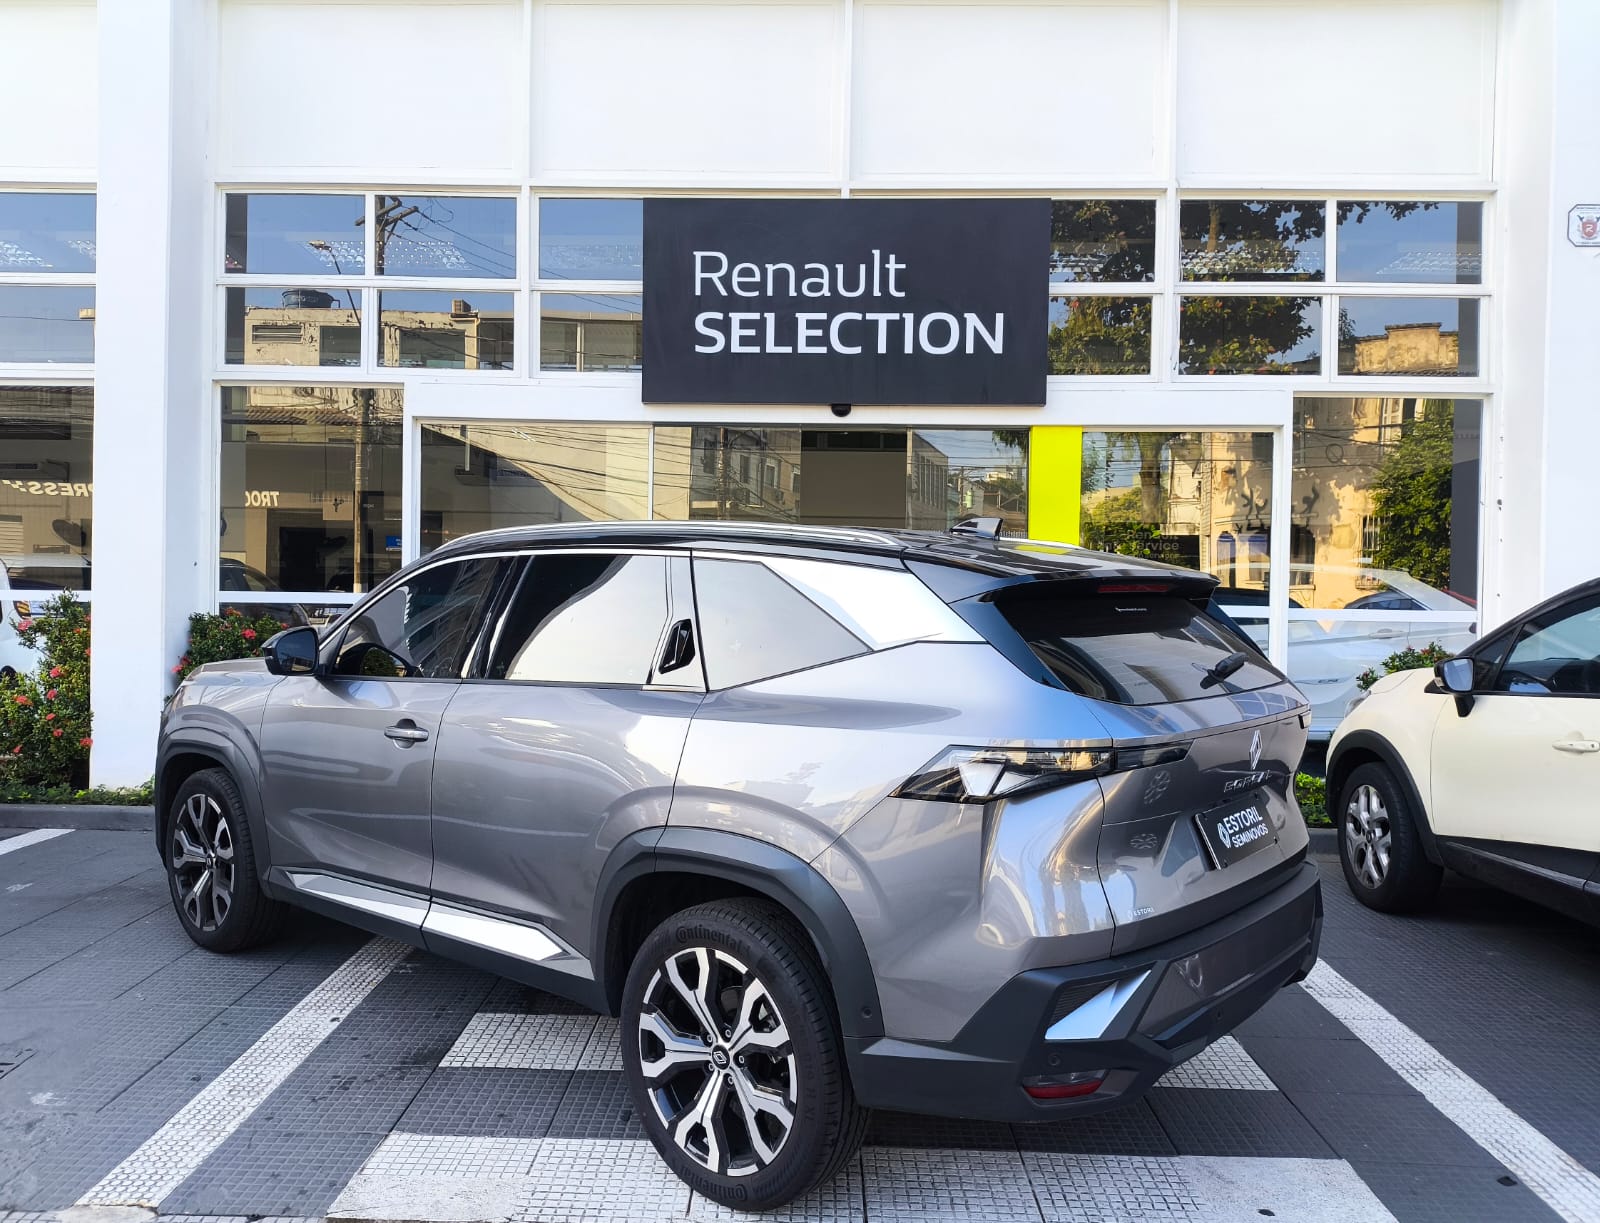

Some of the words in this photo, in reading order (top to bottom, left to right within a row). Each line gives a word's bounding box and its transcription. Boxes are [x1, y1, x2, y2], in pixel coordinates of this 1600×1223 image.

[693, 249, 906, 298] Renault
[695, 311, 1005, 355] SELECTION
[1223, 806, 1263, 834] ESTORIL
[1231, 823, 1269, 848] SEMINOVOS
[675, 924, 743, 953] Continental
